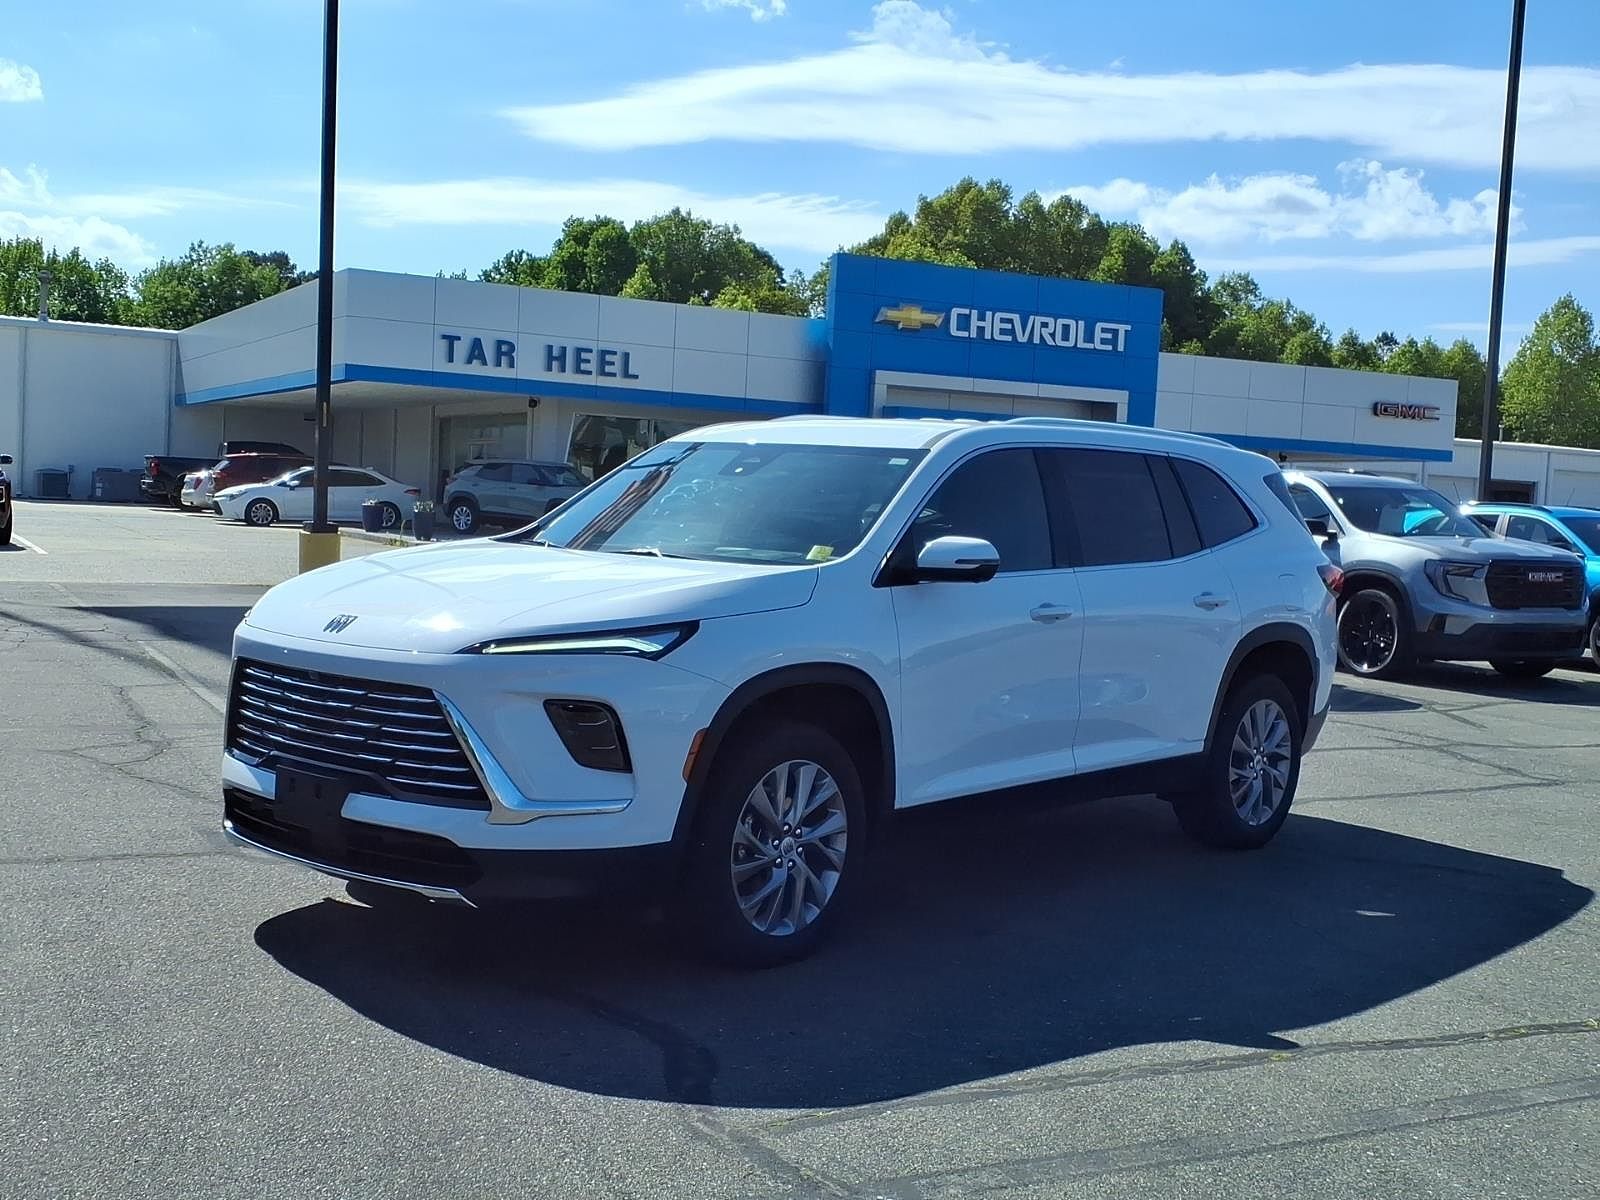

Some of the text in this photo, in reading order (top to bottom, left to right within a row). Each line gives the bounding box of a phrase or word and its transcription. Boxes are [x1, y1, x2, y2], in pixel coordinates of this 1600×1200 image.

[950, 307, 1132, 352] CHEVROLET
[441, 334, 640, 380] TAR HEEL
[1372, 401, 1440, 420] GMC
[1528, 572, 1564, 582] GMC
